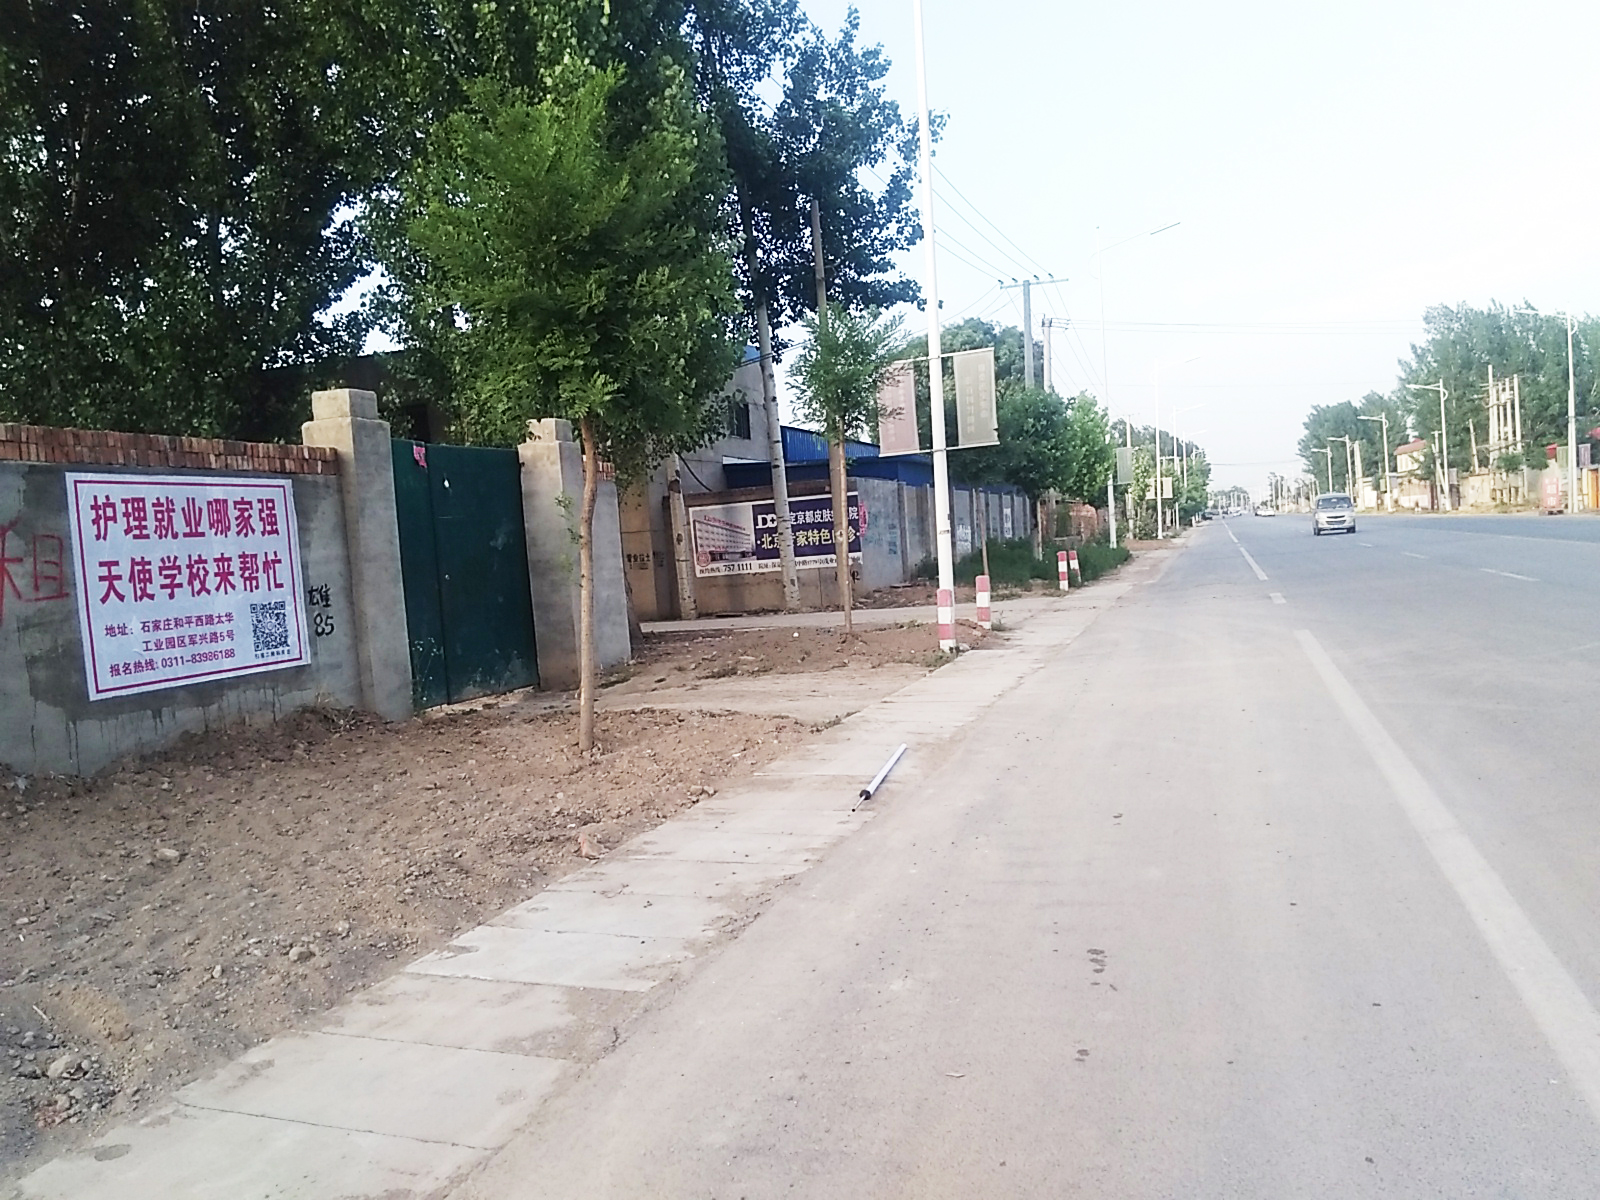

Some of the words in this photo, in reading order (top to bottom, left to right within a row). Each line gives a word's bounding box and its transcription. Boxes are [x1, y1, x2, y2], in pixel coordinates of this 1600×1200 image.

[90, 494, 280, 541] 护理就业哪家强
[789, 506, 859, 525] 定京都皮肤院
[761, 525, 856, 550] 北京家特色诊
[98, 551, 284, 605] 天使学校来帮忙
[722, 564, 735, 572] 757
[737, 562, 752, 571] 1111
[314, 612, 335, 637] 85
[141, 629, 235, 652] 工业园区军兴路5号
